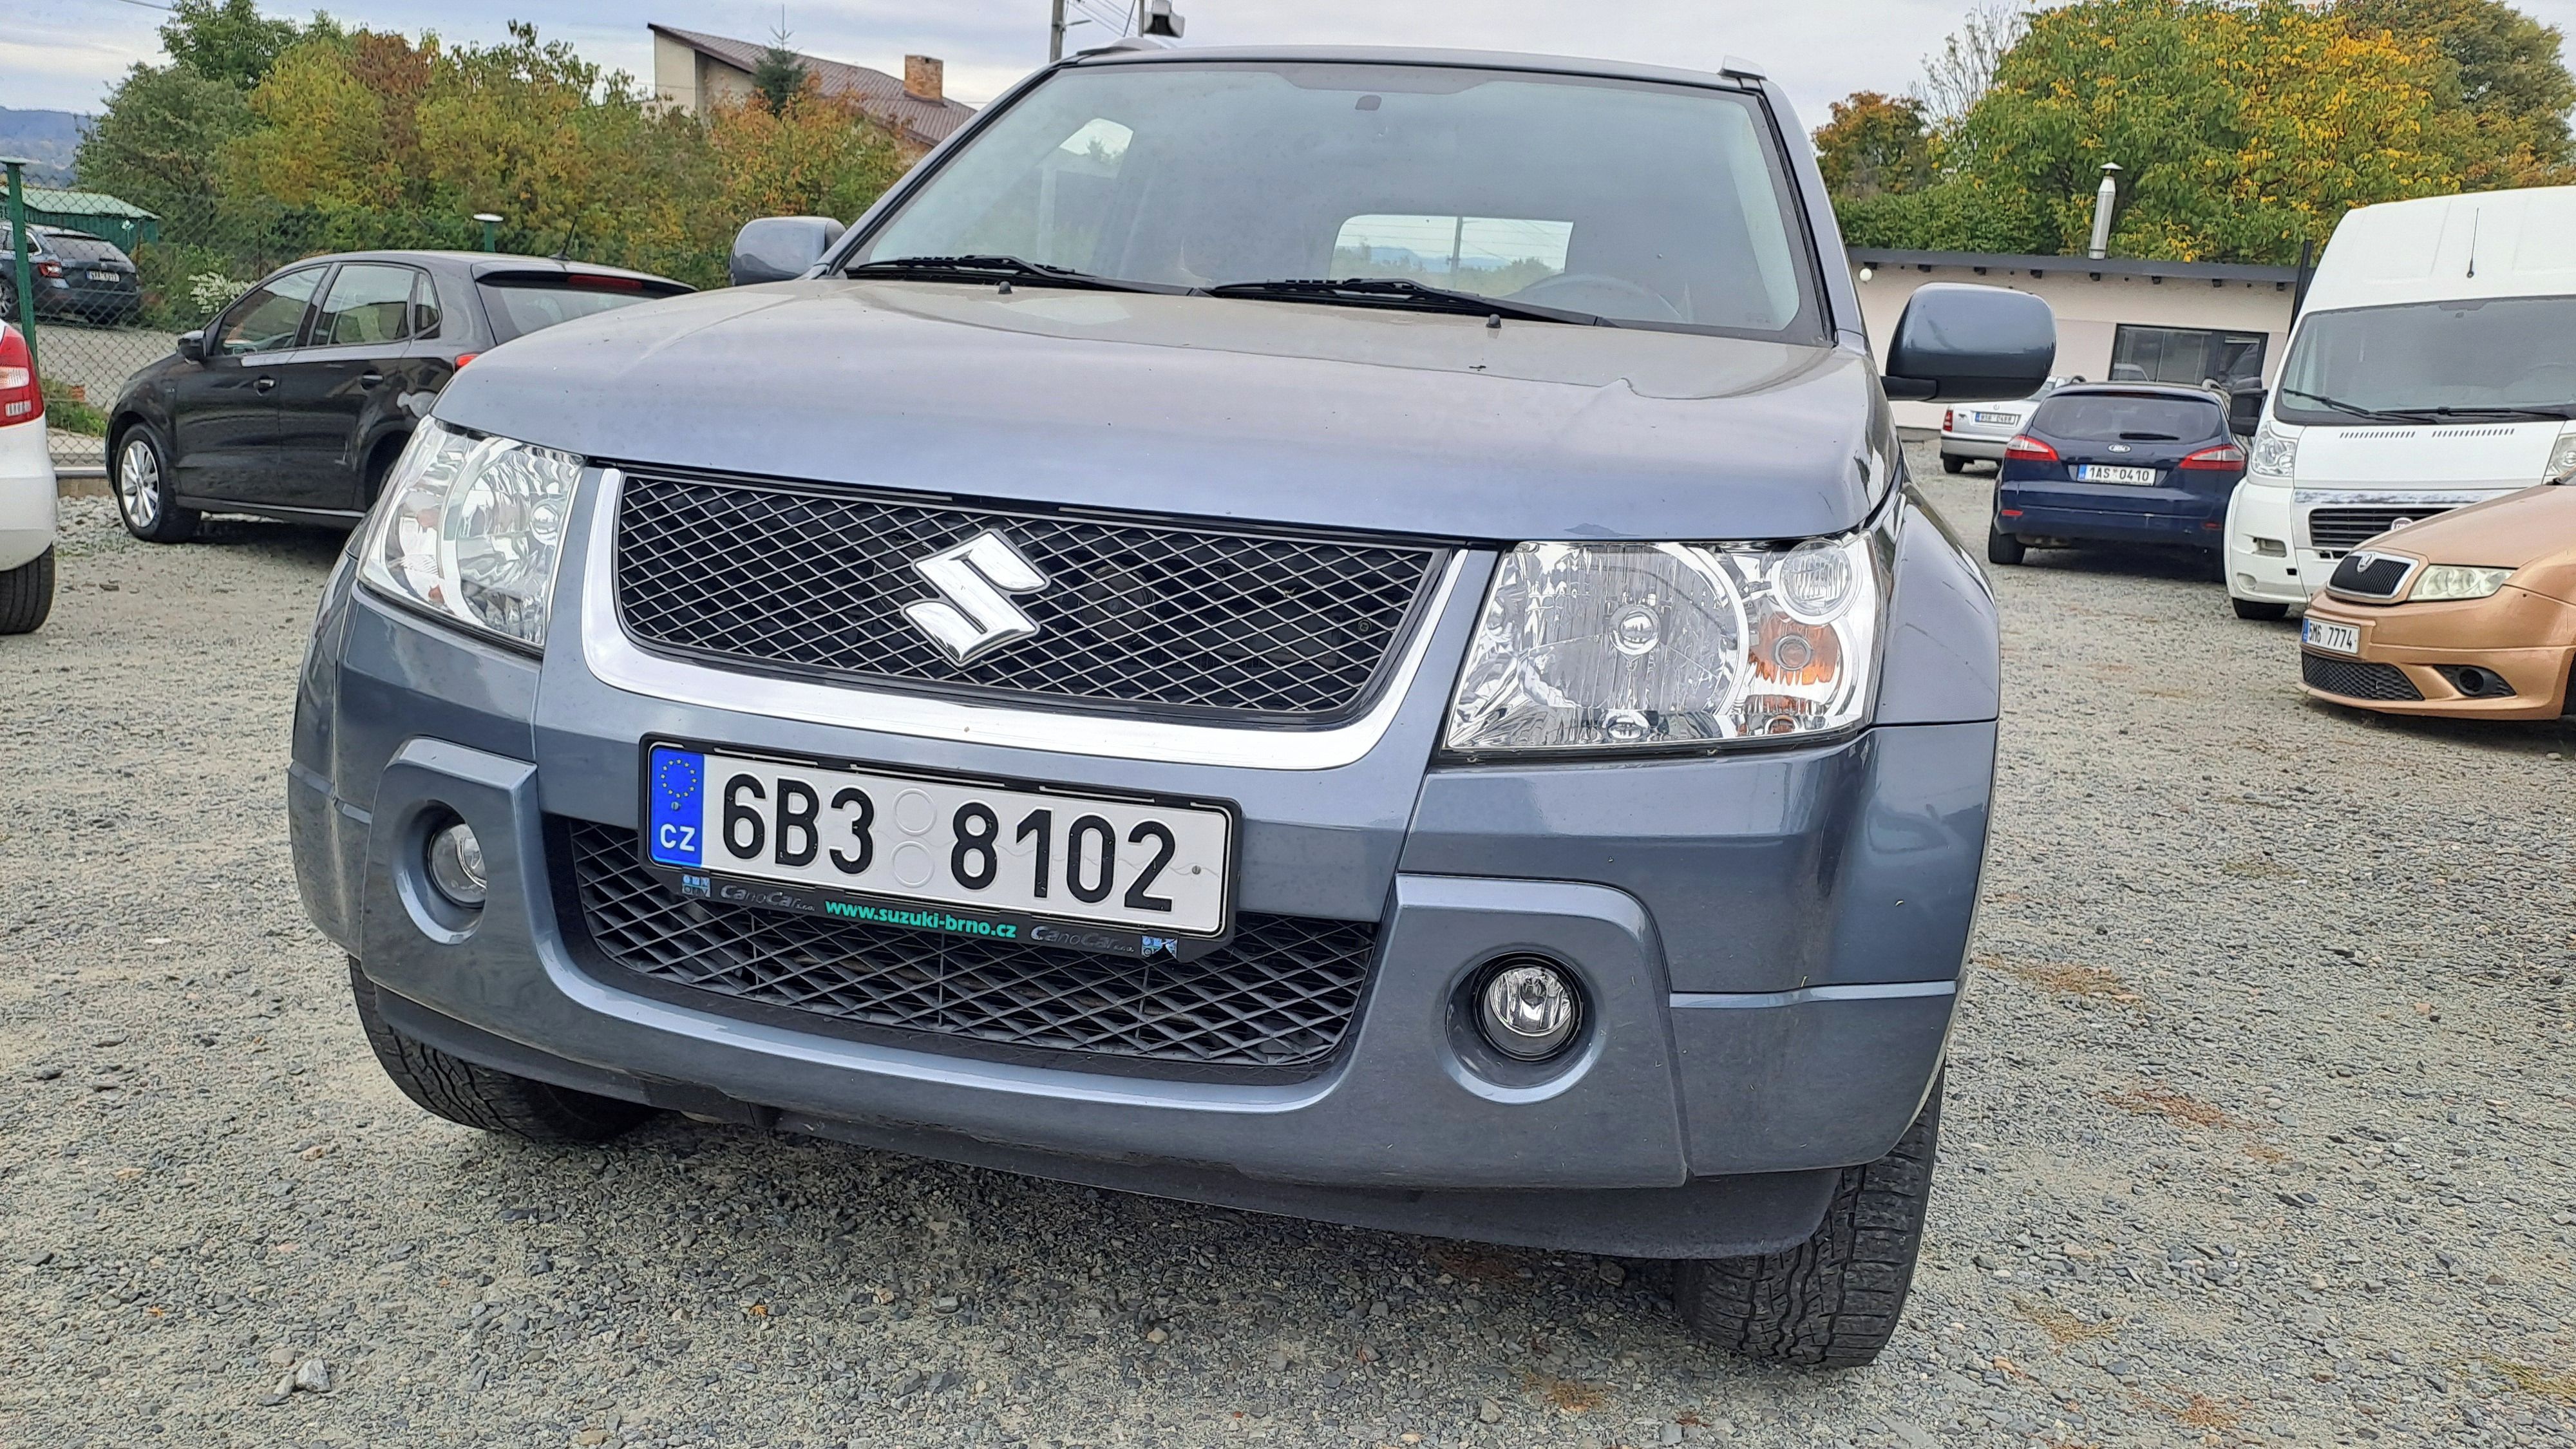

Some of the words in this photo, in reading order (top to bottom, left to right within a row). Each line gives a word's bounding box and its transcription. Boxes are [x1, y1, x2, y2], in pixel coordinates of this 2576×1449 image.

[2089, 467, 2110, 478] 1AS
[2119, 469, 2150, 482] 0410
[2309, 623, 2322, 643] 5M6
[2327, 627, 2353, 650] 7774
[660, 824, 696, 851] CZ
[723, 773, 875, 875] 6B3
[951, 802, 1176, 912] 8102
[720, 885, 801, 907] CanoCar
[825, 901, 1017, 938] www.suzuki-brno.cz
[1030, 925, 1119, 950] CanoCar
